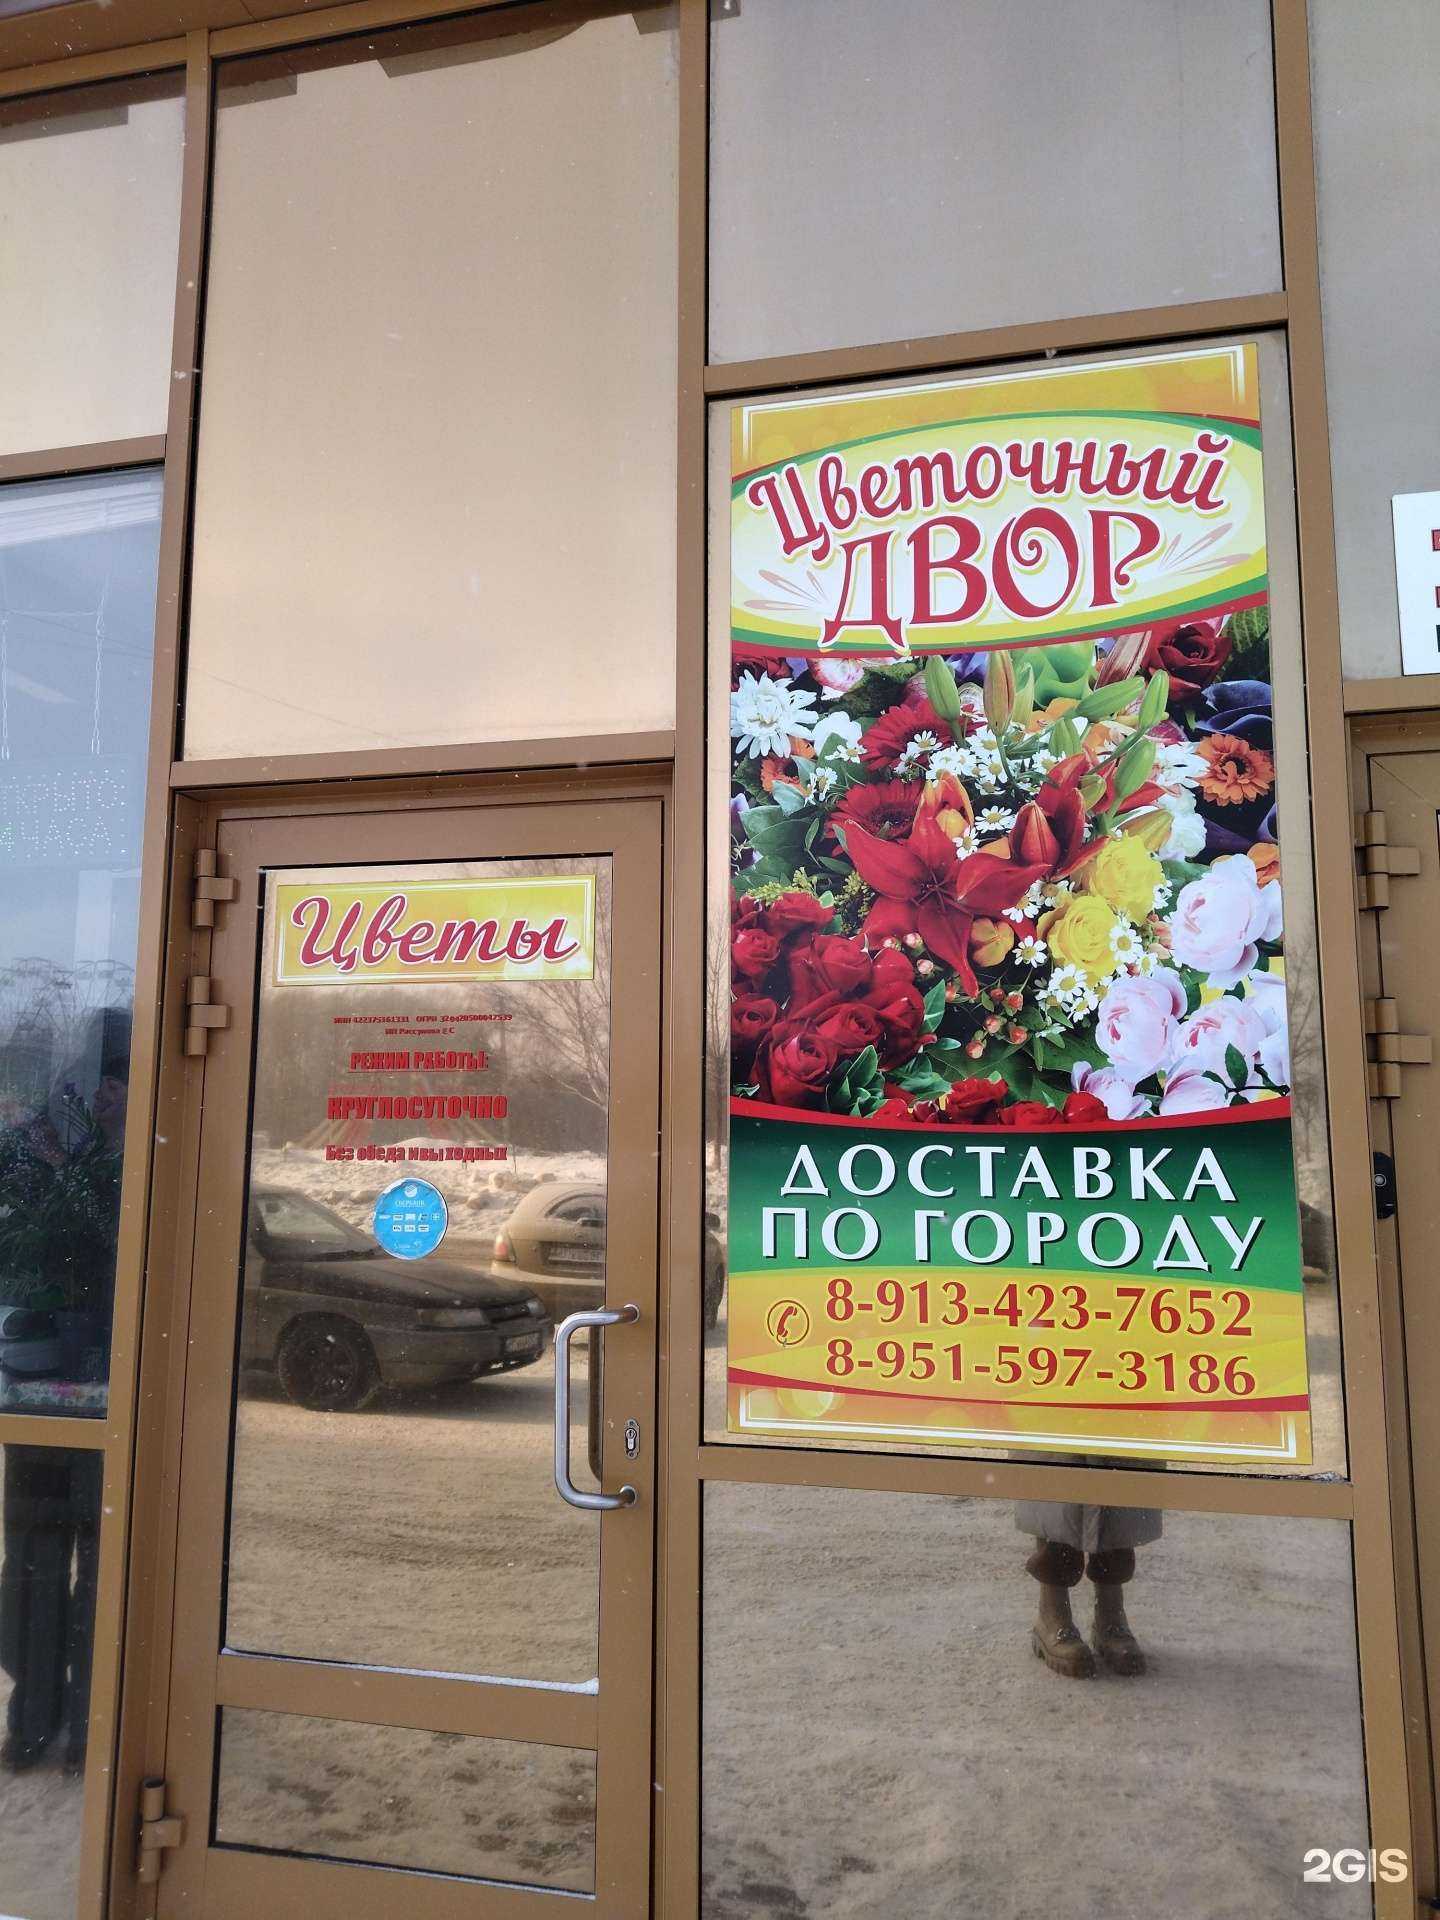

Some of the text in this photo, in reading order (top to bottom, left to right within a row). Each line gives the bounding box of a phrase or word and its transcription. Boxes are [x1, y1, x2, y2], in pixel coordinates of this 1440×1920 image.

[749, 433, 1230, 560] Цветочный
[819, 507, 1161, 648] ДВОР
[0, 778, 117, 815] ТКРЫТО
[291, 894, 579, 972] Цветы
[350, 1051, 410, 1070] РЕЖИМ
[327, 1095, 508, 1120] КРУГЛОСУТОЧНО
[325, 1145, 354, 1161] Без
[356, 1144, 406, 1163] обеда
[780, 1143, 1236, 1202] ДОСТАВКА
[761, 1207, 1264, 1272] ПО ГОРОДУ
[825, 1278, 1253, 1337] 8-913-423-7652
[825, 1338, 1257, 1396] 8-951-597-3186
